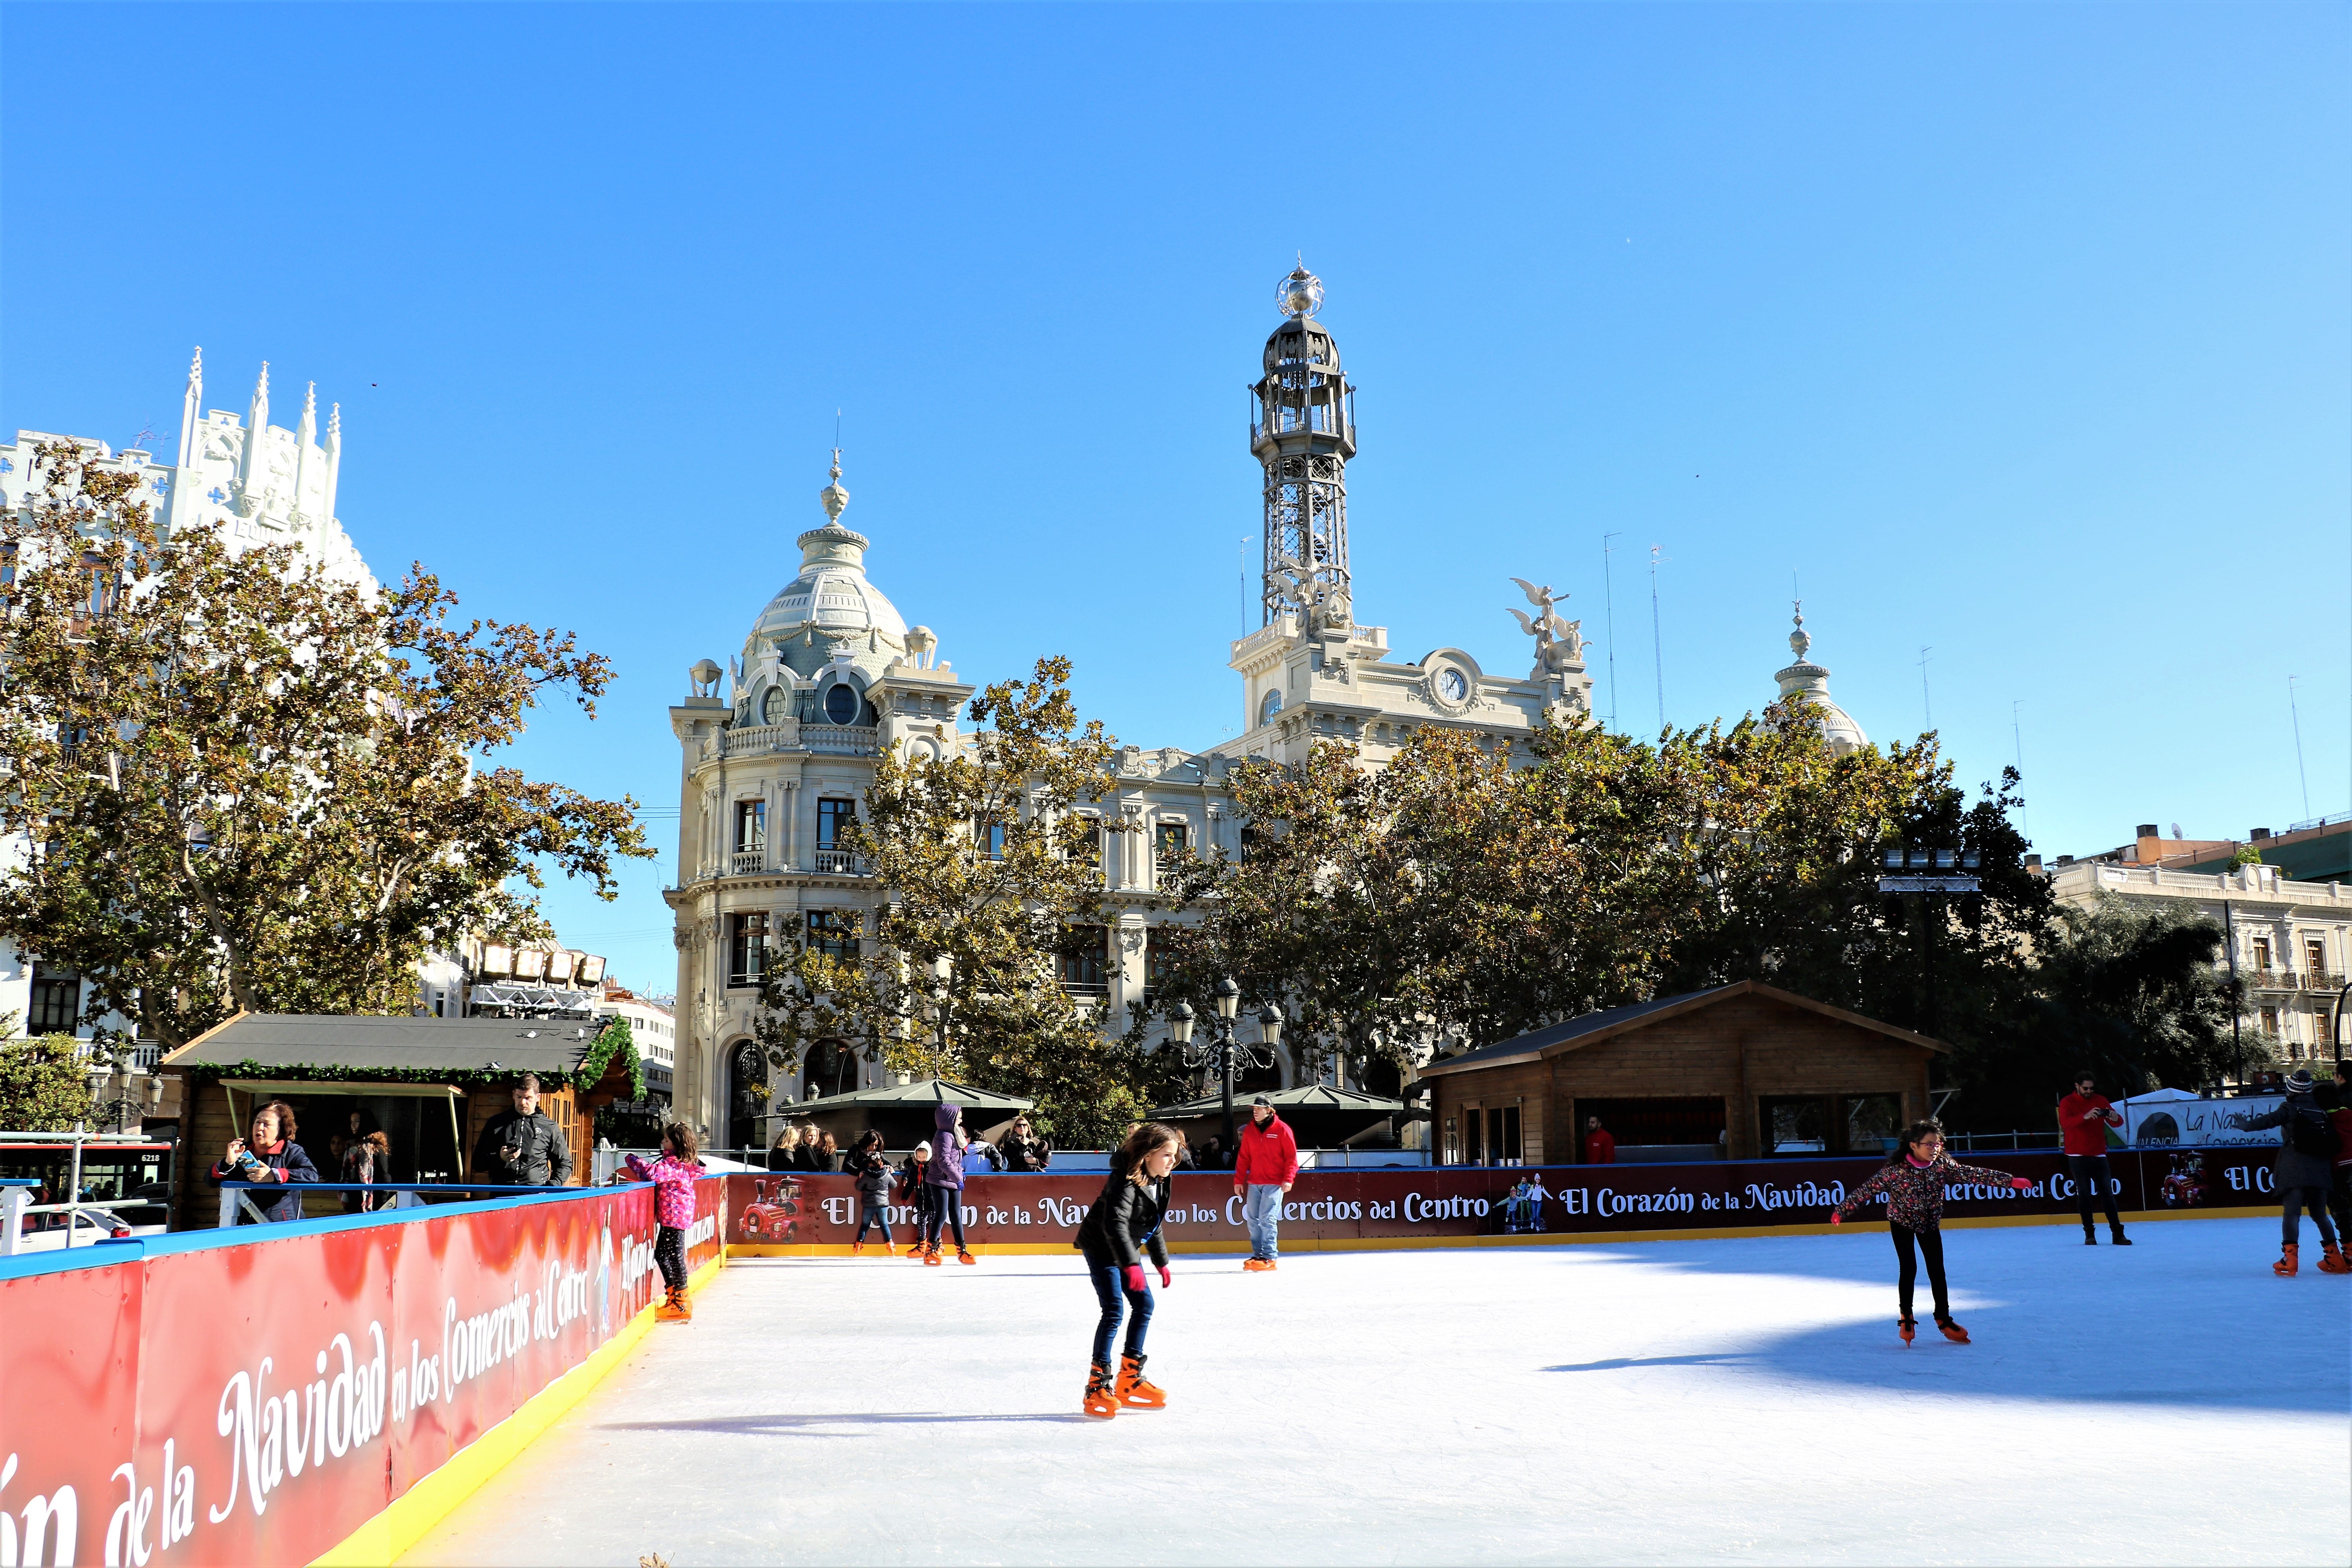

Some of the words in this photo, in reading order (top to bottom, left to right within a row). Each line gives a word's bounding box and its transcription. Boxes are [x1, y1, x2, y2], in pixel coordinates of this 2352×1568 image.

[2187, 1107, 2203, 1131] La
[2225, 1167, 2249, 1191] El
[821, 1196, 855, 1225] El
[987, 1205, 1009, 1225] de
[1014, 1205, 1031, 1225] la
[1164, 1209, 1187, 1225] en
[1192, 1203, 1218, 1223] los
[1370, 1200, 1396, 1220] del
[1404, 1192, 1489, 1223] Centro
[1560, 1188, 1588, 1217] El
[1597, 1187, 1694, 1217] Corazón
[1702, 1192, 1721, 1210] de
[1725, 1192, 1740, 1209] la
[1745, 1180, 1845, 1211] Navidad
[104, 1462, 154, 1568] de
[161, 1437, 195, 1551] la
[209, 1320, 387, 1524] Navidad
[410, 1338, 439, 1411] los
[443, 1279, 530, 1404] Comercios
